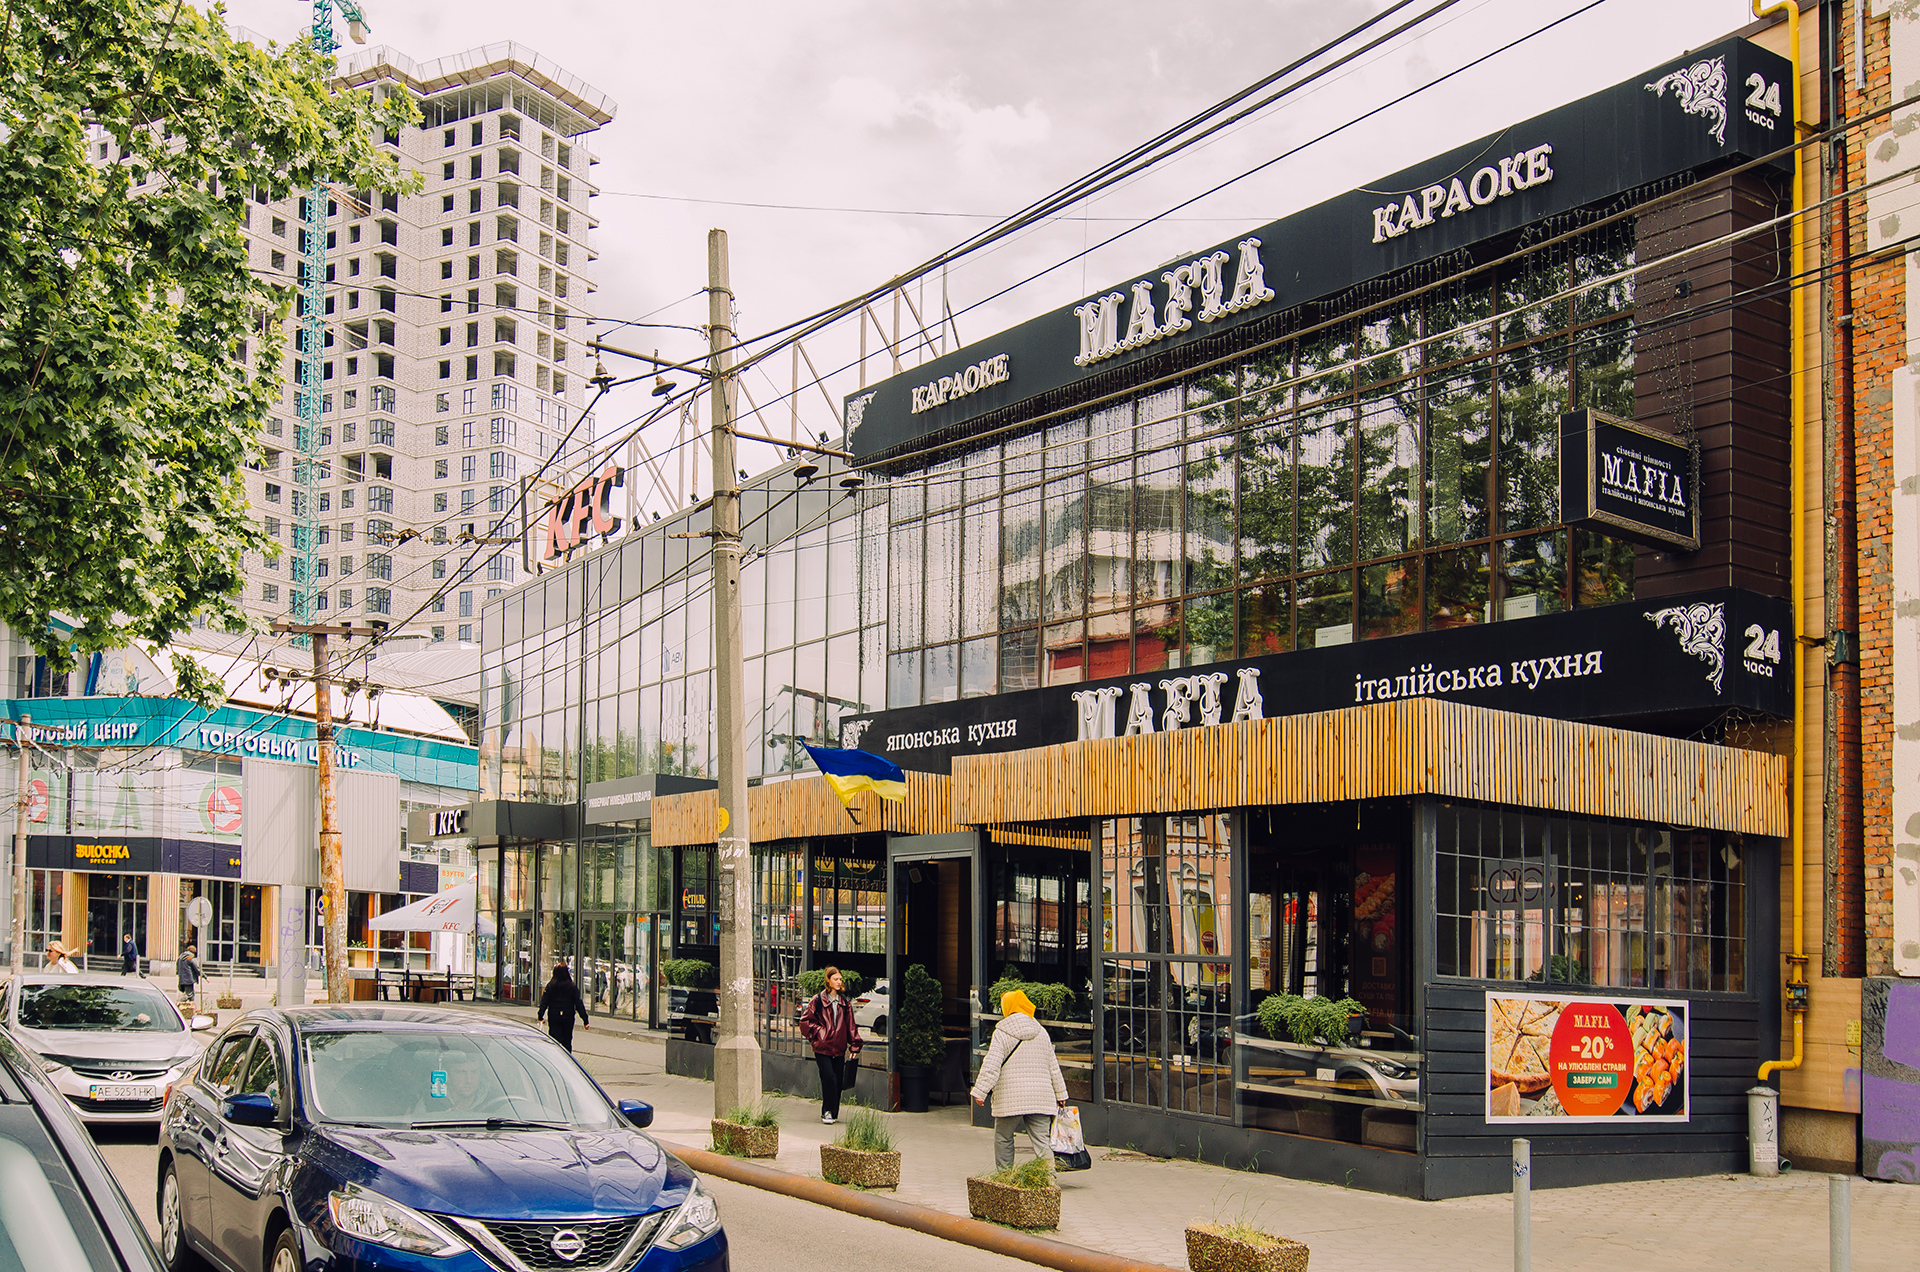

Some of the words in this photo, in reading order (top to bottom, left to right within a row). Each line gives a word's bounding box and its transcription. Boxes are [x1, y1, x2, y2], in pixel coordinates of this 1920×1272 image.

[1745, 72, 1782, 117] 24
[1745, 108, 1775, 131] часа
[1372, 143, 1553, 244] КАРАОКЕ
[1073, 237, 1276, 366] MAFIA
[911, 353, 1010, 414] КАРАОКЕ
[1616, 445, 1642, 461] сімейні
[1643, 454, 1672, 470] цінності
[1601, 451, 1686, 508] MAFIA
[544, 466, 624, 560] KFC
[1602, 485, 1633, 502] італійська
[1638, 497, 1666, 512] японська
[1668, 505, 1686, 518] кухня
[1744, 624, 1781, 664] 24
[1355, 664, 1502, 703] італійська
[1510, 650, 1602, 691] кухня
[1743, 658, 1774, 678] часа
[1071, 667, 1264, 741] MAFIA
[94, 722, 138, 742] ЦЕНТР
[200, 728, 299, 759] ТОРГОВЫЙ
[886, 724, 960, 752] японська
[967, 719, 1017, 747] кухня
[438, 809, 461, 835] KFC
[442, 869, 465, 878] ВЗУТТЯ
[442, 921, 460, 931] KFC
[1573, 1015, 1611, 1028] MAFIA
[1571, 1036, 1614, 1059] -20%
[1558, 1062, 1568, 1071] НА
[1569, 1062, 1602, 1071] УЛЮБЛЕНІ
[1602, 1063, 1627, 1071] СТРАВИ
[1573, 1076, 1596, 1085] ЗАБЕРУ
[1597, 1076, 1612, 1085] САМ
[98, 1087, 111, 1096] AE
[115, 1087, 137, 1096] 5251
[140, 1087, 153, 1096] HK
